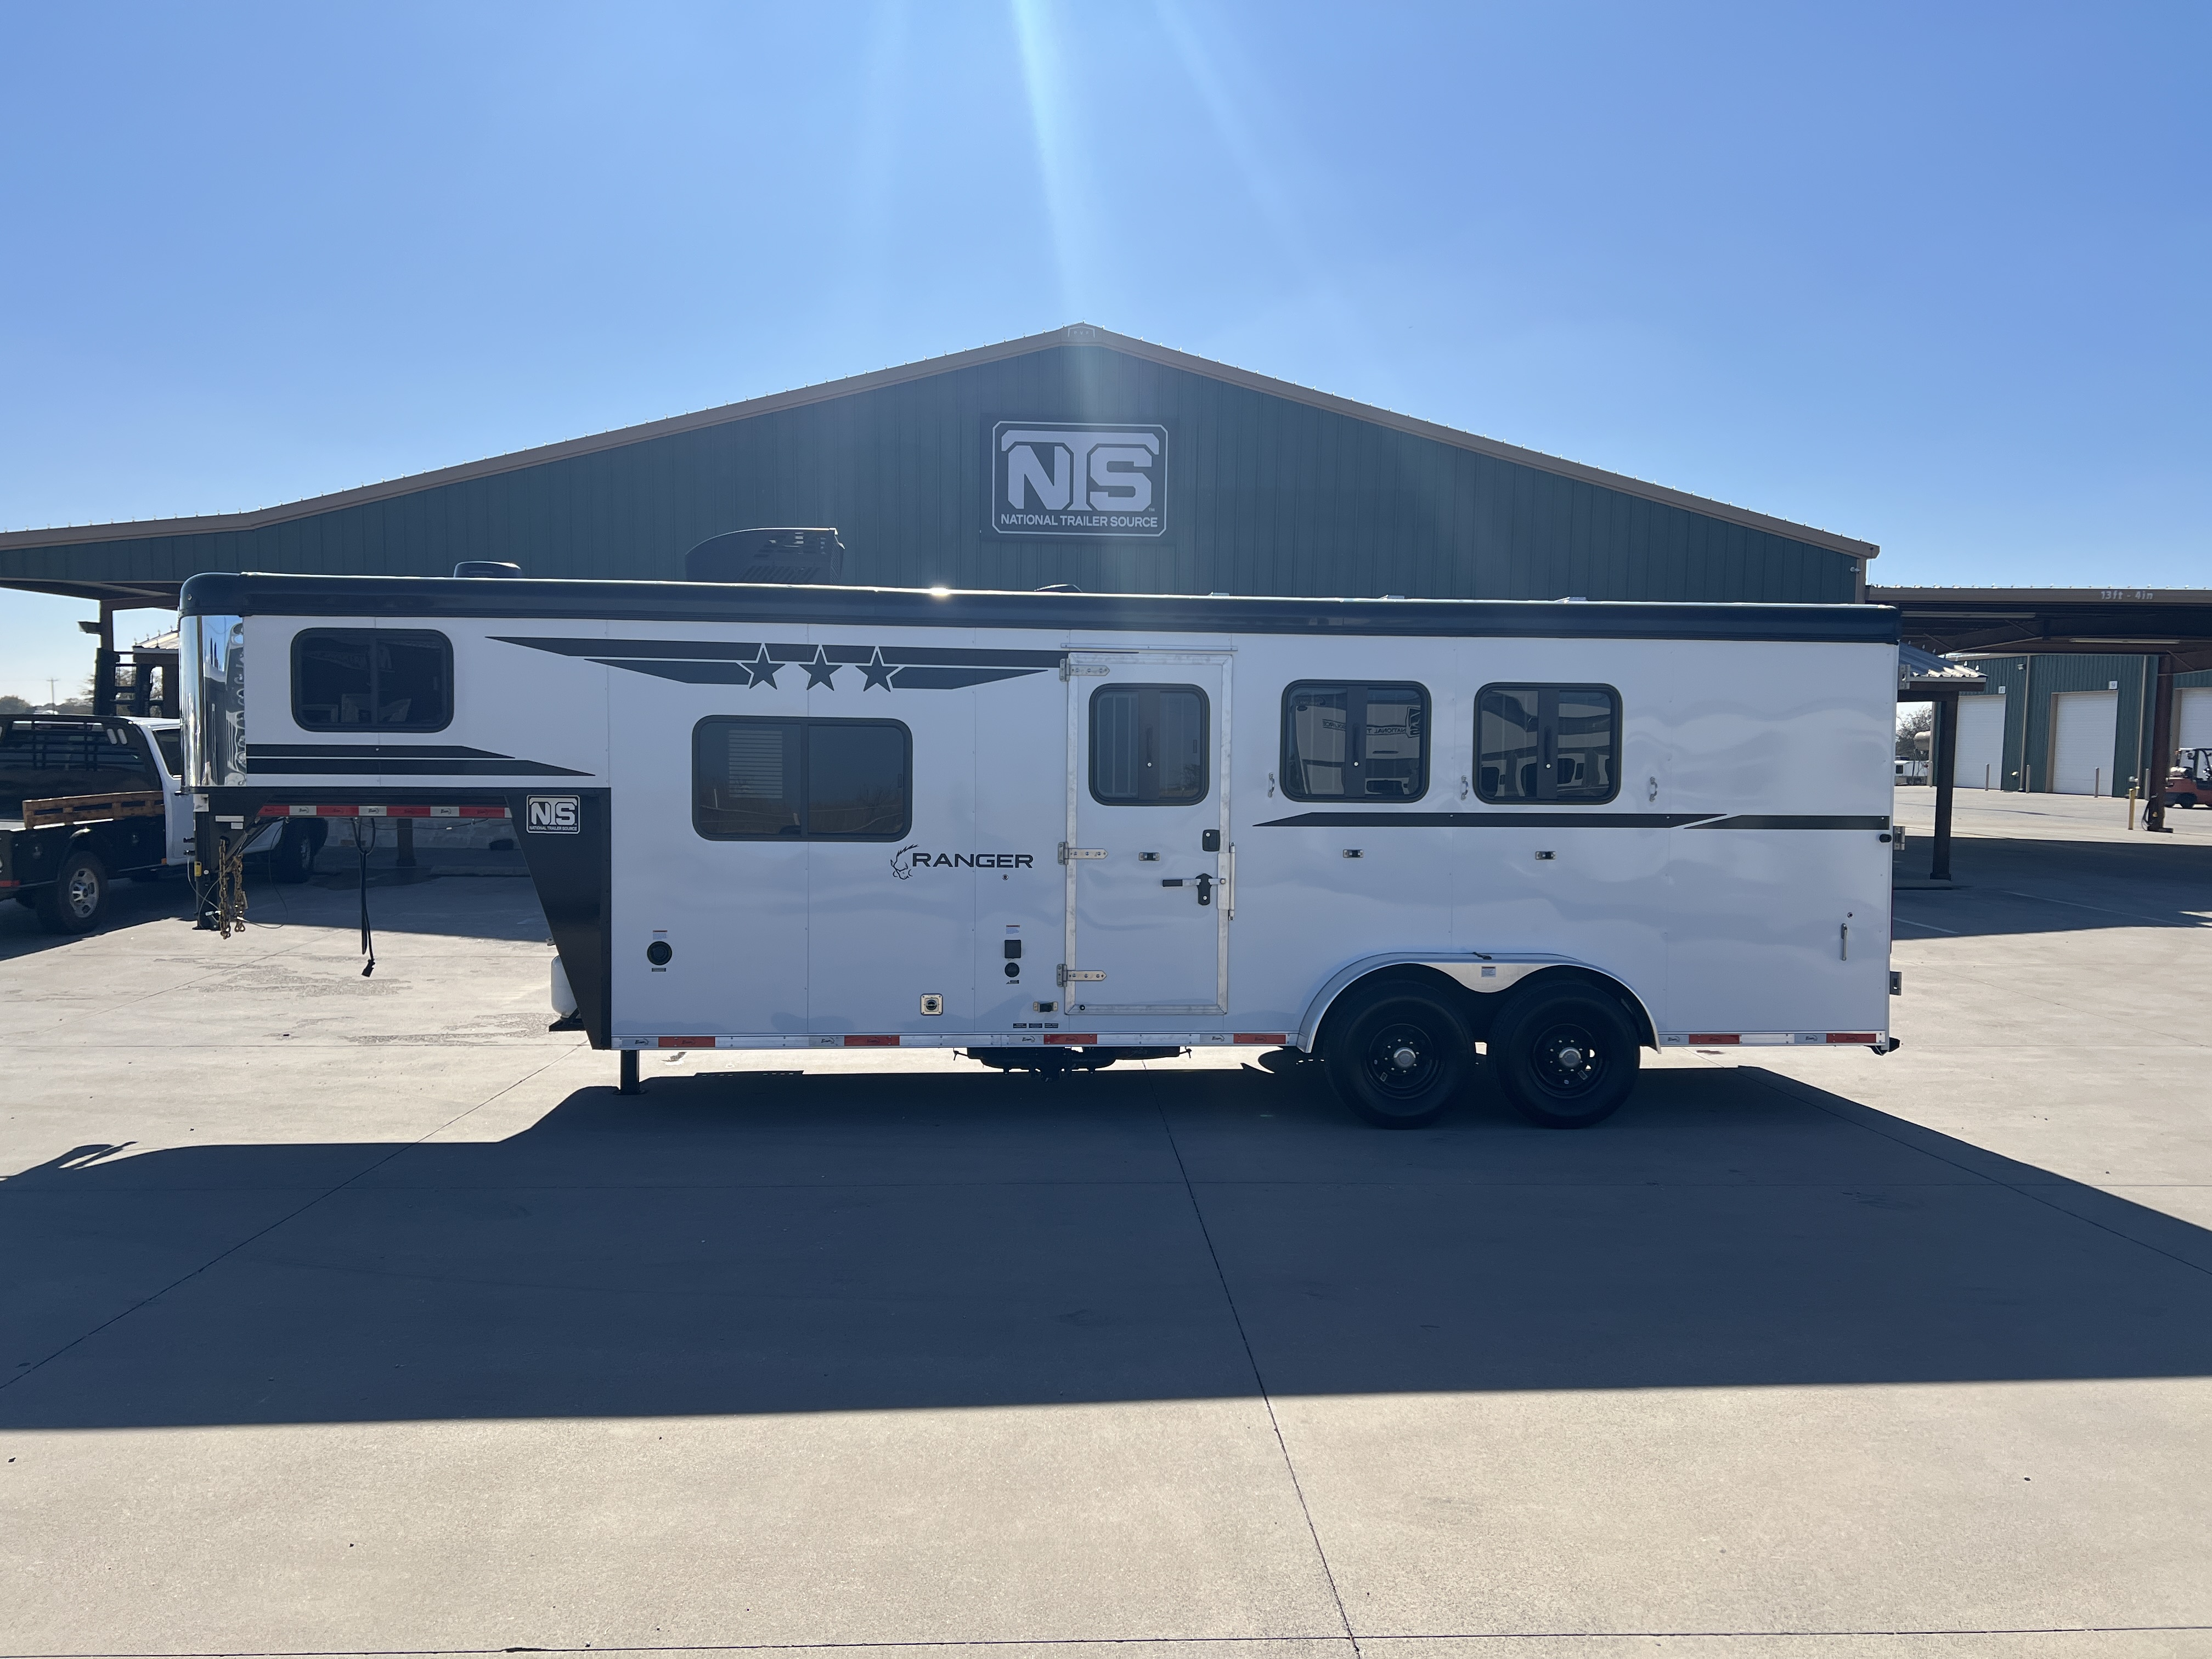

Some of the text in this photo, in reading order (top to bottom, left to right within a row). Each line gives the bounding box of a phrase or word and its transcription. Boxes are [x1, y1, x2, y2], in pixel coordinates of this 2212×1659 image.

[1002, 430, 1159, 512] NTS
[1001, 514, 1158, 527] NATIONAL TRAILER SOURCE
[2101, 591, 2123, 600] 13ft
[2135, 591, 2153, 600] 4in
[529, 798, 577, 826] NTS
[912, 853, 1034, 868] RANGER
